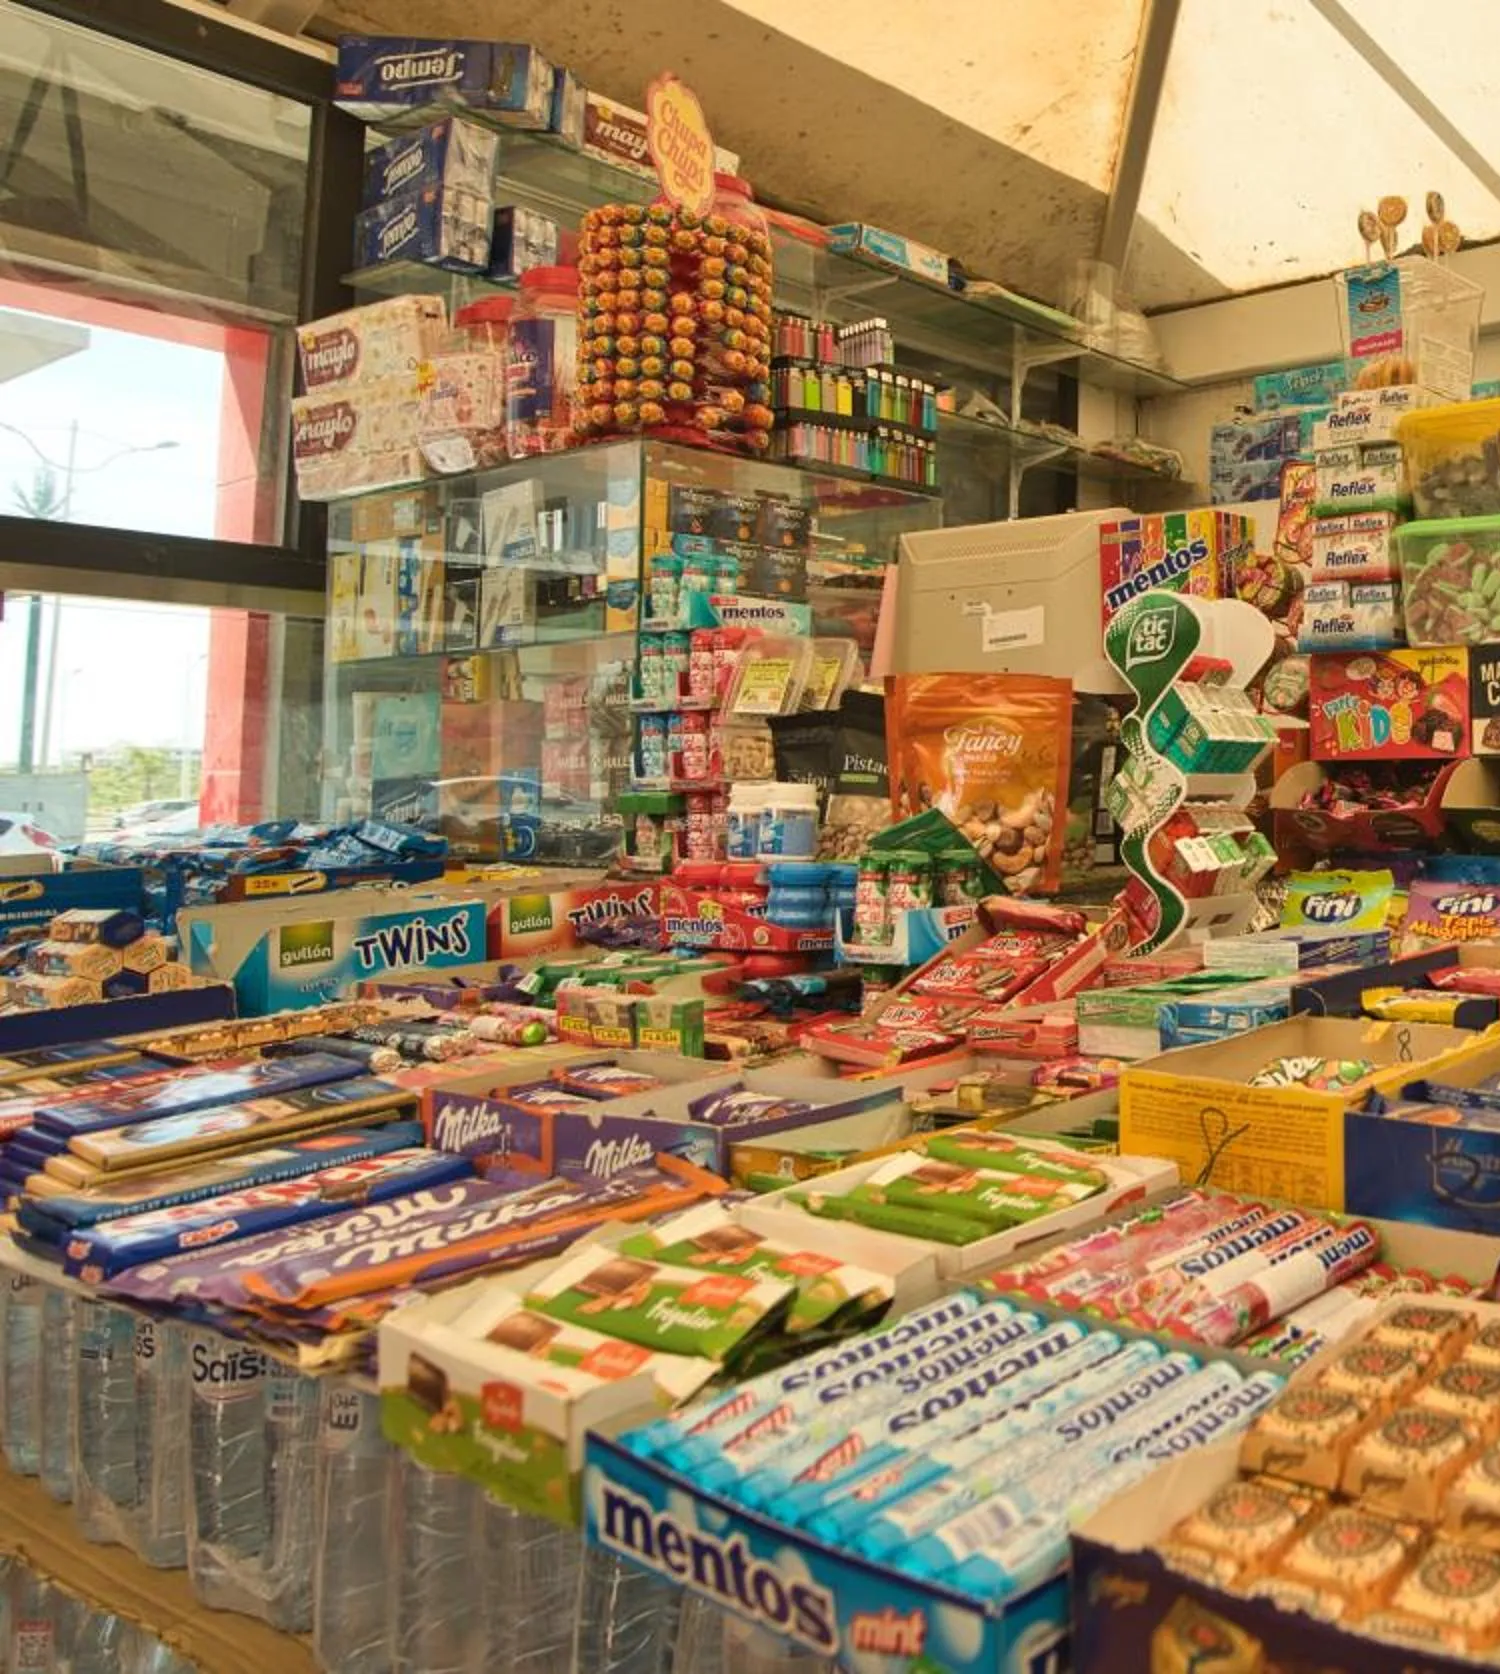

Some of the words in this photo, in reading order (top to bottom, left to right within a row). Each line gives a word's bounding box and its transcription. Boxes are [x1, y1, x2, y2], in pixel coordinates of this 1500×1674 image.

[380, 51, 462, 84] Tempo
[594, 123, 650, 160] may
[1329, 409, 1371, 430] Reflex
[1330, 480, 1376, 498] Reflex
[1325, 551, 1367, 568] Reflex
[1107, 537, 1210, 610] mentos
[722, 606, 785, 620] mentos
[1139, 613, 1170, 637] tic
[1312, 618, 1355, 635] Reflex
[1135, 632, 1167, 653] tac
[944, 727, 1023, 757] Fancy
[843, 753, 890, 775] Pistac
[1306, 891, 1360, 923] Fini
[1438, 892, 1498, 915] Fini
[511, 916, 552, 933] gullón
[666, 917, 723, 934] mentos
[1442, 914, 1496, 930] Tapis
[797, 935, 834, 950] ment
[281, 946, 332, 965] gullón
[641, 1030, 679, 1043] FLASH
[435, 1103, 503, 1152] Milka
[584, 1133, 656, 1179] Milka
[333, 1190, 582, 1268] Milka
[893, 1319, 1030, 1396] mentos
[1056, 1360, 1187, 1445] mentos
[1144, 1379, 1274, 1462] mentos
[600, 1482, 837, 1654] mentos
[851, 1609, 928, 1656] mint
